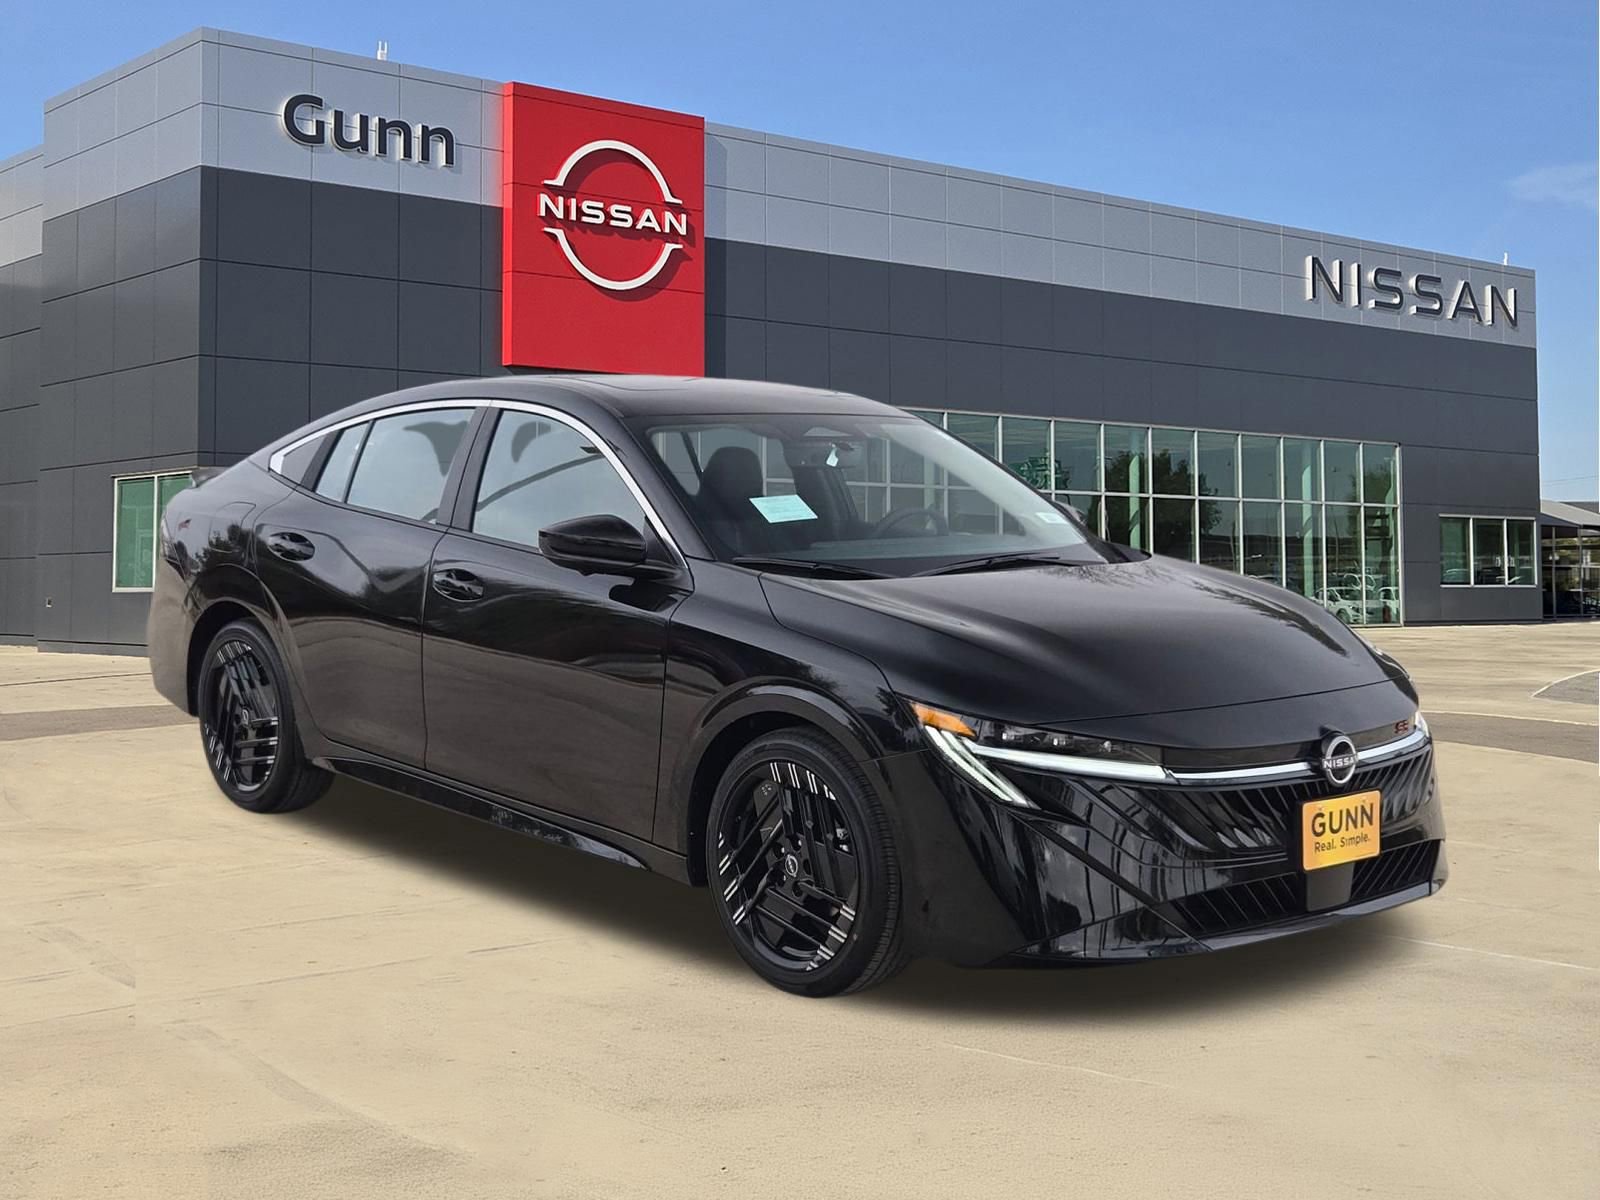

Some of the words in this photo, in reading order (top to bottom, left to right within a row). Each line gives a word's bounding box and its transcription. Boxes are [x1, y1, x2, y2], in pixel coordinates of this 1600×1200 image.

[283, 93, 455, 167] Gunn
[537, 193, 688, 236] NISSAN
[1305, 255, 1518, 328] NISSAN
[1311, 802, 1374, 838] GUNN
[1314, 838, 1337, 854] Real.
[1340, 832, 1371, 848] Simple.
